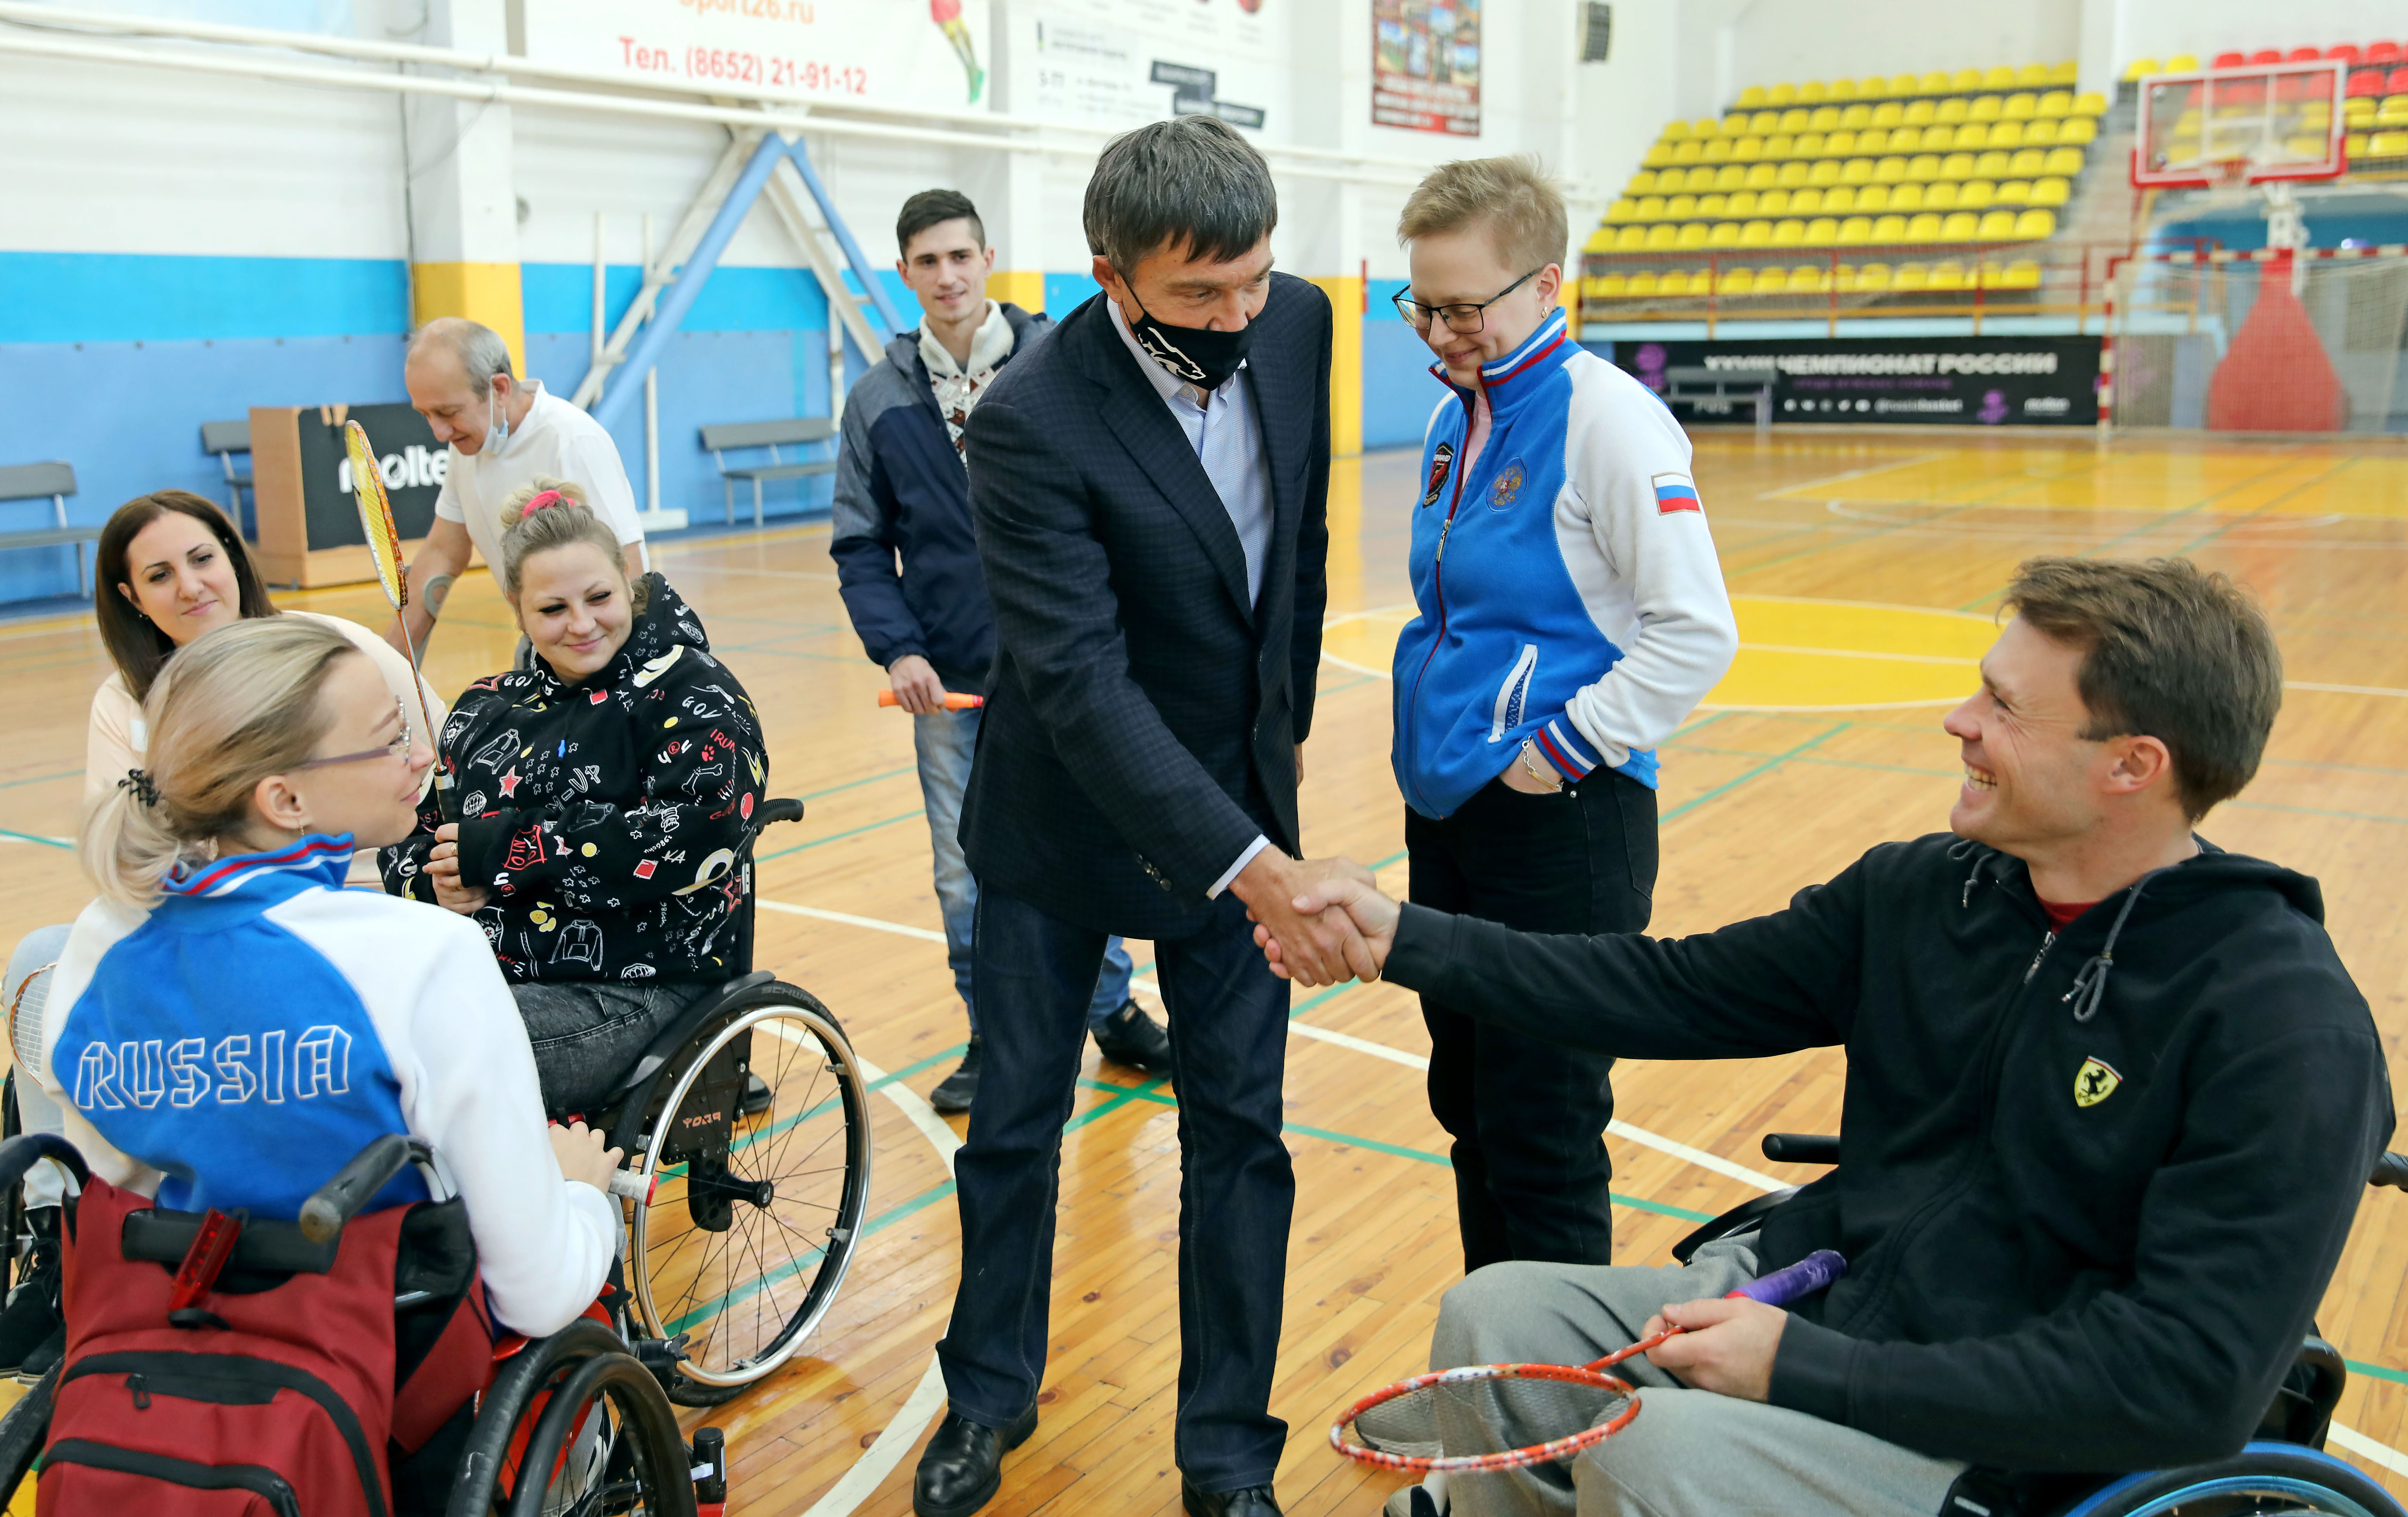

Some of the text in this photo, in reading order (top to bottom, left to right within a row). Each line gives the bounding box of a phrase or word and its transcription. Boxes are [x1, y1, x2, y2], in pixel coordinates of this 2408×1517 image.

[680, 0, 815, 24] port26.ru
[685, 45, 764, 86] (8652)
[1937, 352, 2057, 375] РОССИИ
[339, 445, 449, 493] molte
[75, 1024, 352, 1110] RUSSIA
